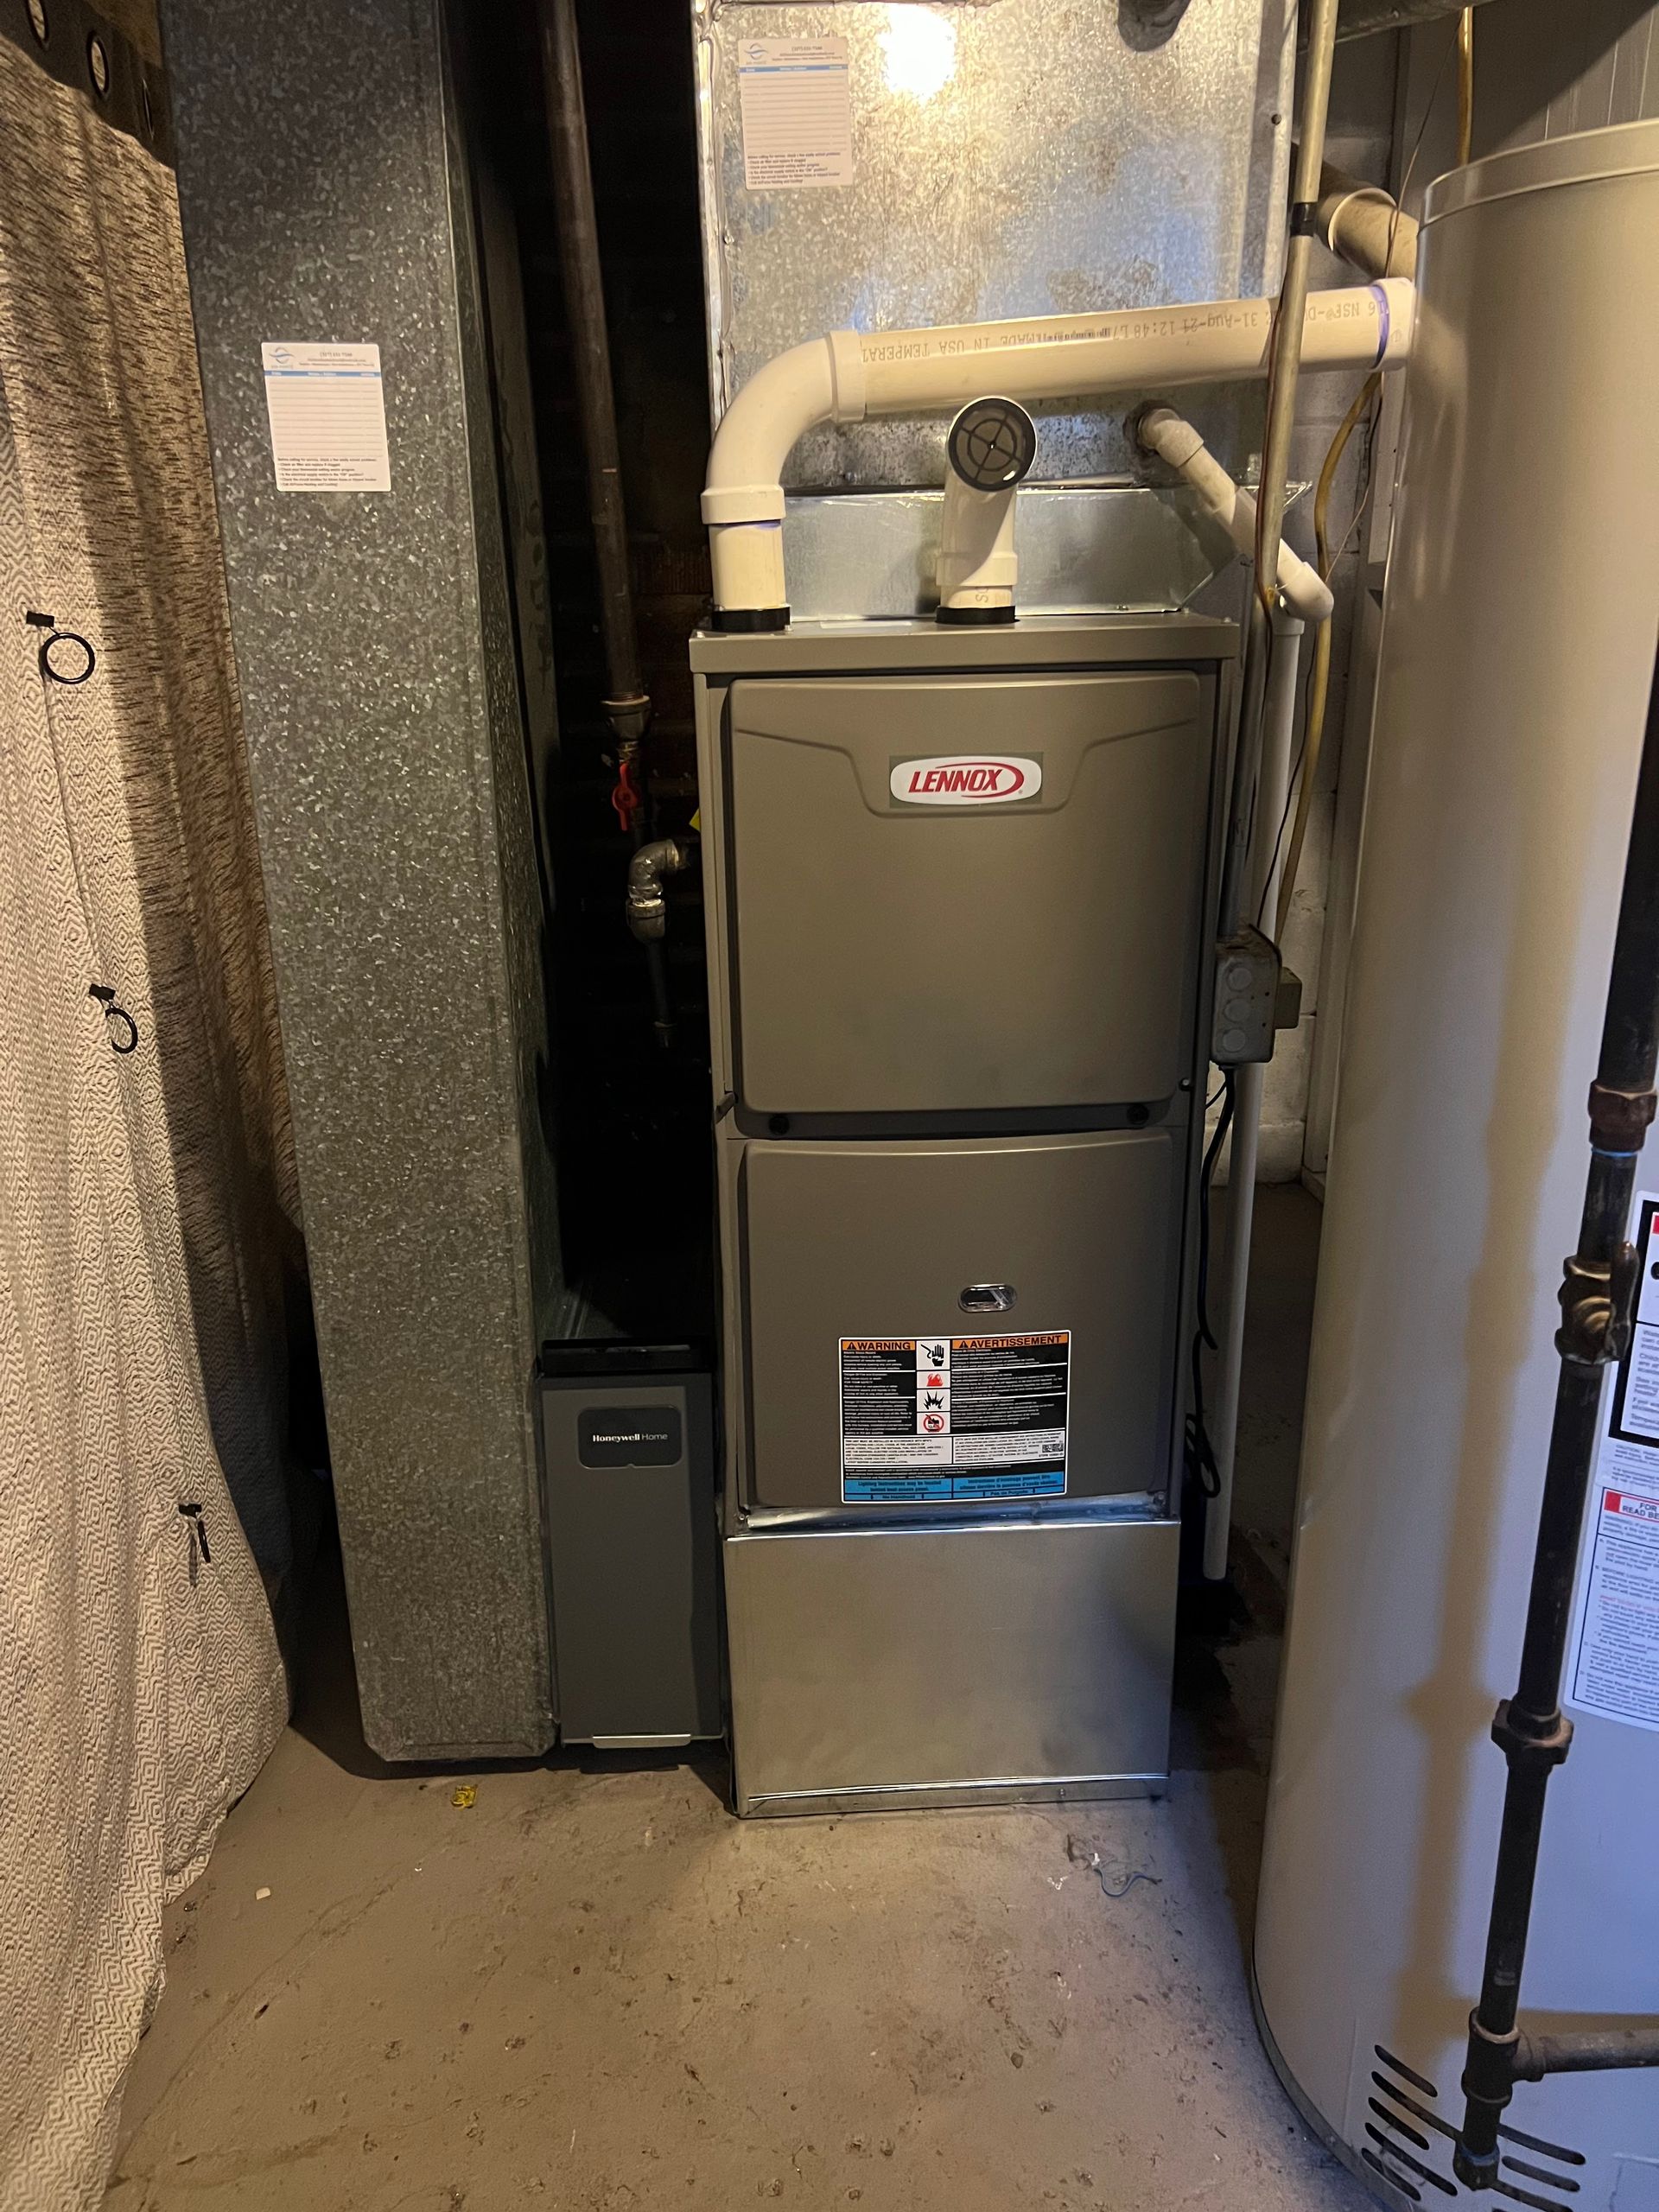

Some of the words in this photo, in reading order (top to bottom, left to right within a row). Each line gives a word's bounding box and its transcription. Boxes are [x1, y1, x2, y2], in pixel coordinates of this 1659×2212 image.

[1134, 321, 1174, 338] 12:48
[939, 340, 964, 353] USA
[975, 338, 990, 350] IN
[908, 769, 1002, 793] LENNOX
[857, 1342, 911, 1351] WARNING
[969, 1335, 1061, 1348] AVERTISSEMENT
[592, 1433, 640, 1443] Honeywell
[1622, 1505, 1646, 1516] READ
[1639, 1503, 1657, 1512] FOR
